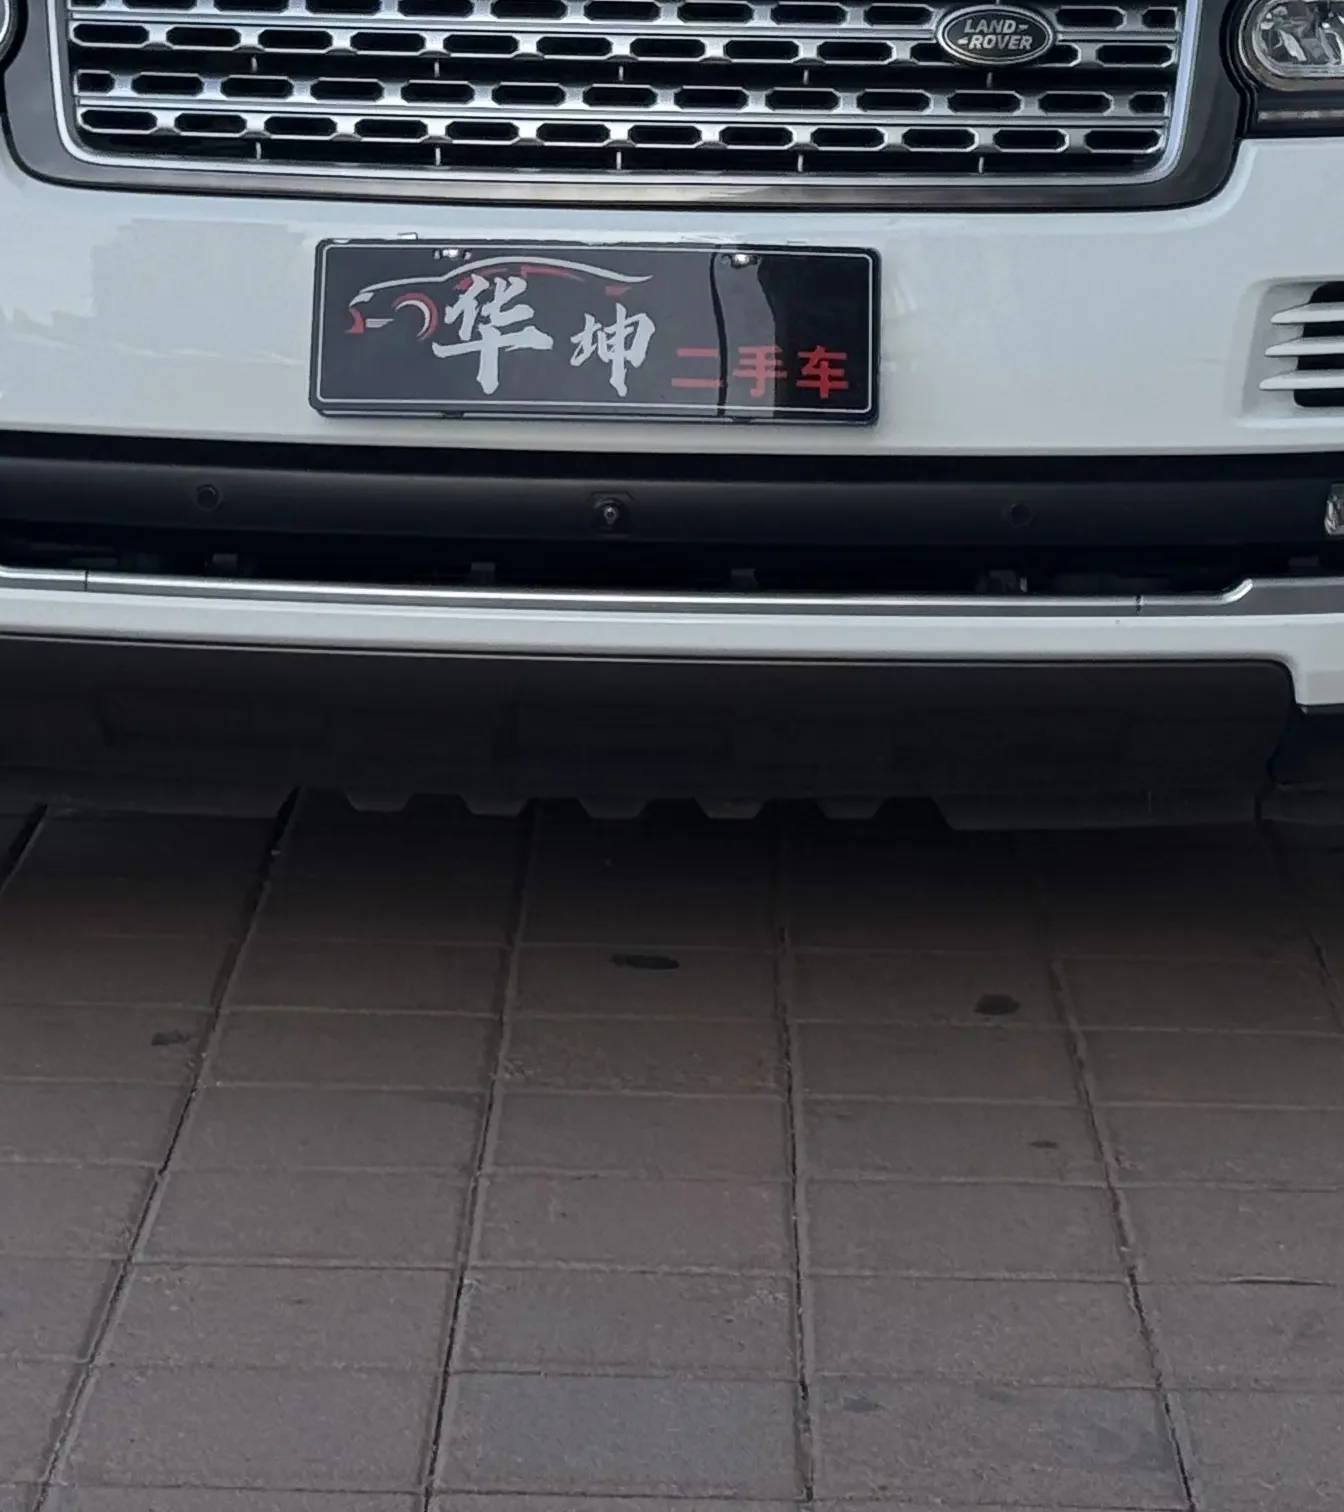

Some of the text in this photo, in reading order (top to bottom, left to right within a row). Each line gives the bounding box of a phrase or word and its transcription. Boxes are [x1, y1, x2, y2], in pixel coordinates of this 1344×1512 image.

[963, 19, 1017, 34] LAND
[968, 34, 1033, 50] ROVER
[432, 273, 849, 399] 华坤 二手车
